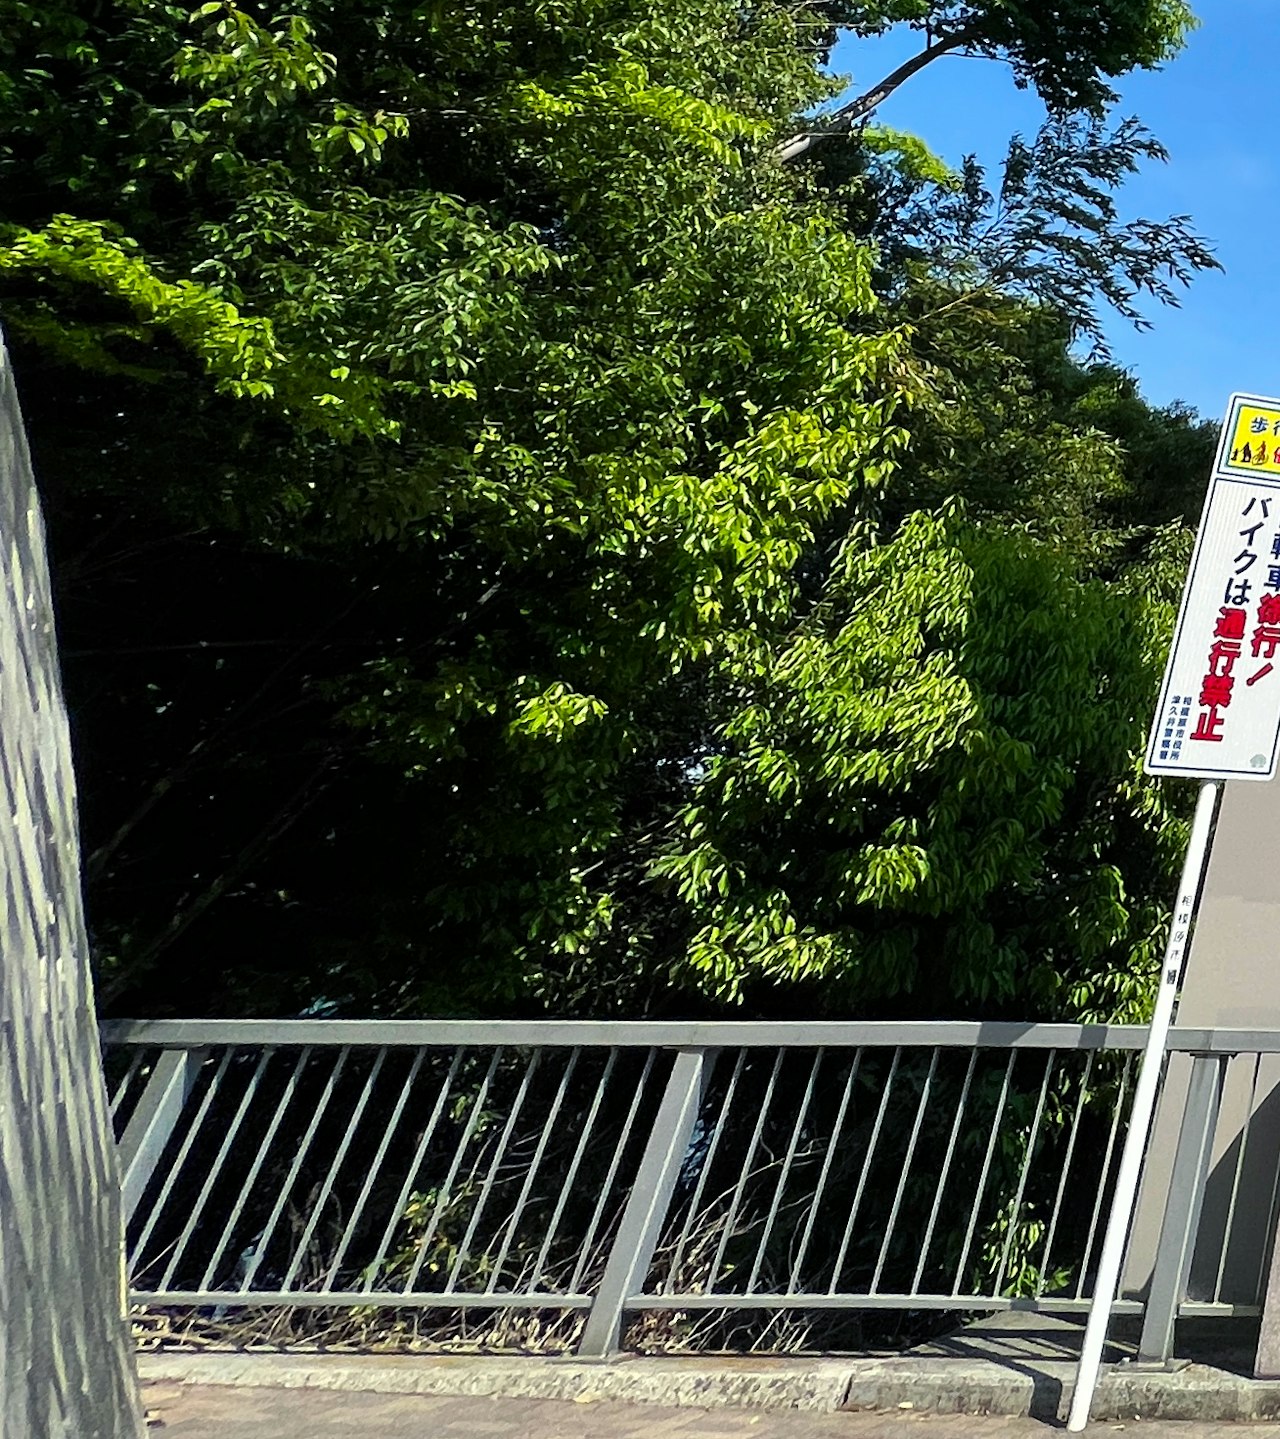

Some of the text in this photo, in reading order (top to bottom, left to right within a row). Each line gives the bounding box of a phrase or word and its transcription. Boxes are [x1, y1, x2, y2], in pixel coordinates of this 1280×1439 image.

[1189, 496, 1273, 742] バイクは通行禁止
